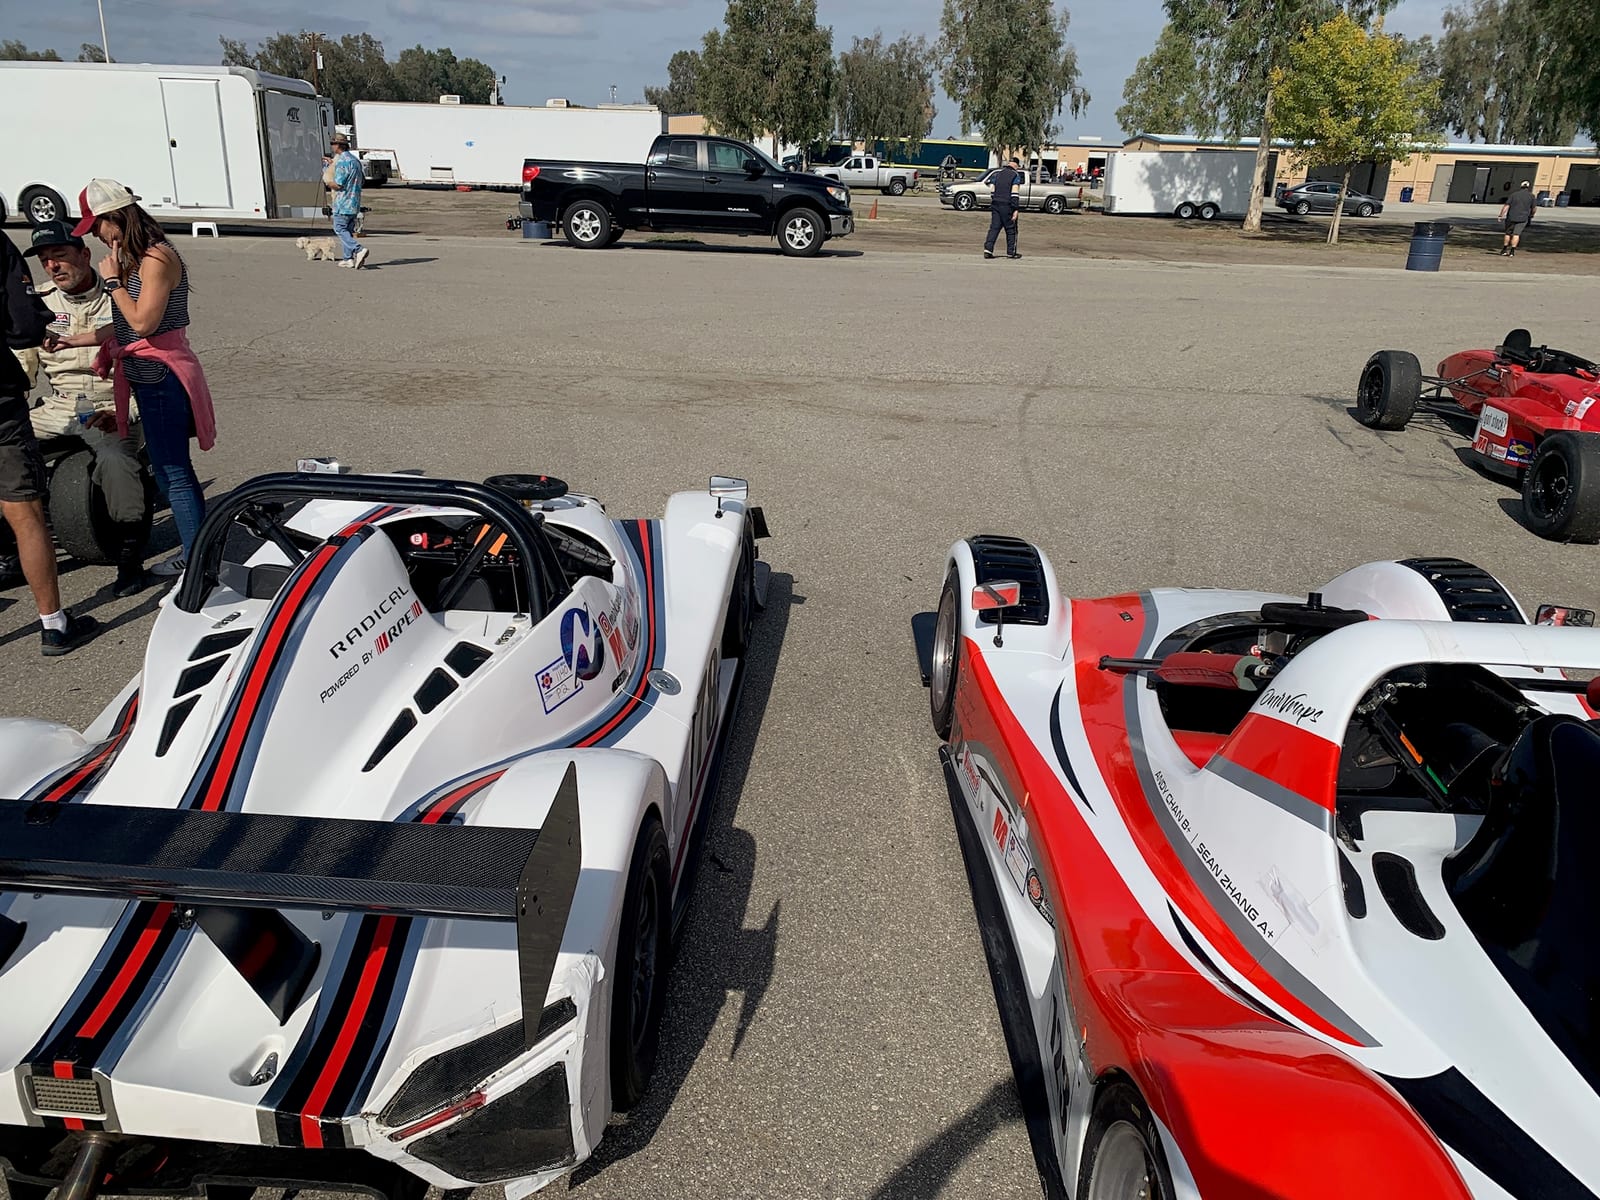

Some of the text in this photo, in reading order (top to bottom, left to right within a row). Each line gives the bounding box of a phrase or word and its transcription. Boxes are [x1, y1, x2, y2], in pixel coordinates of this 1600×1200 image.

[329, 586, 409, 659] RADICAL
[387, 609, 415, 643] RPE
[1154, 770, 1168, 795] ANDY
[1165, 793, 1184, 822] CHAN
[1196, 842, 1223, 878] SEAN
[1219, 874, 1260, 922] ZHANG
[1257, 921, 1274, 939] A+
